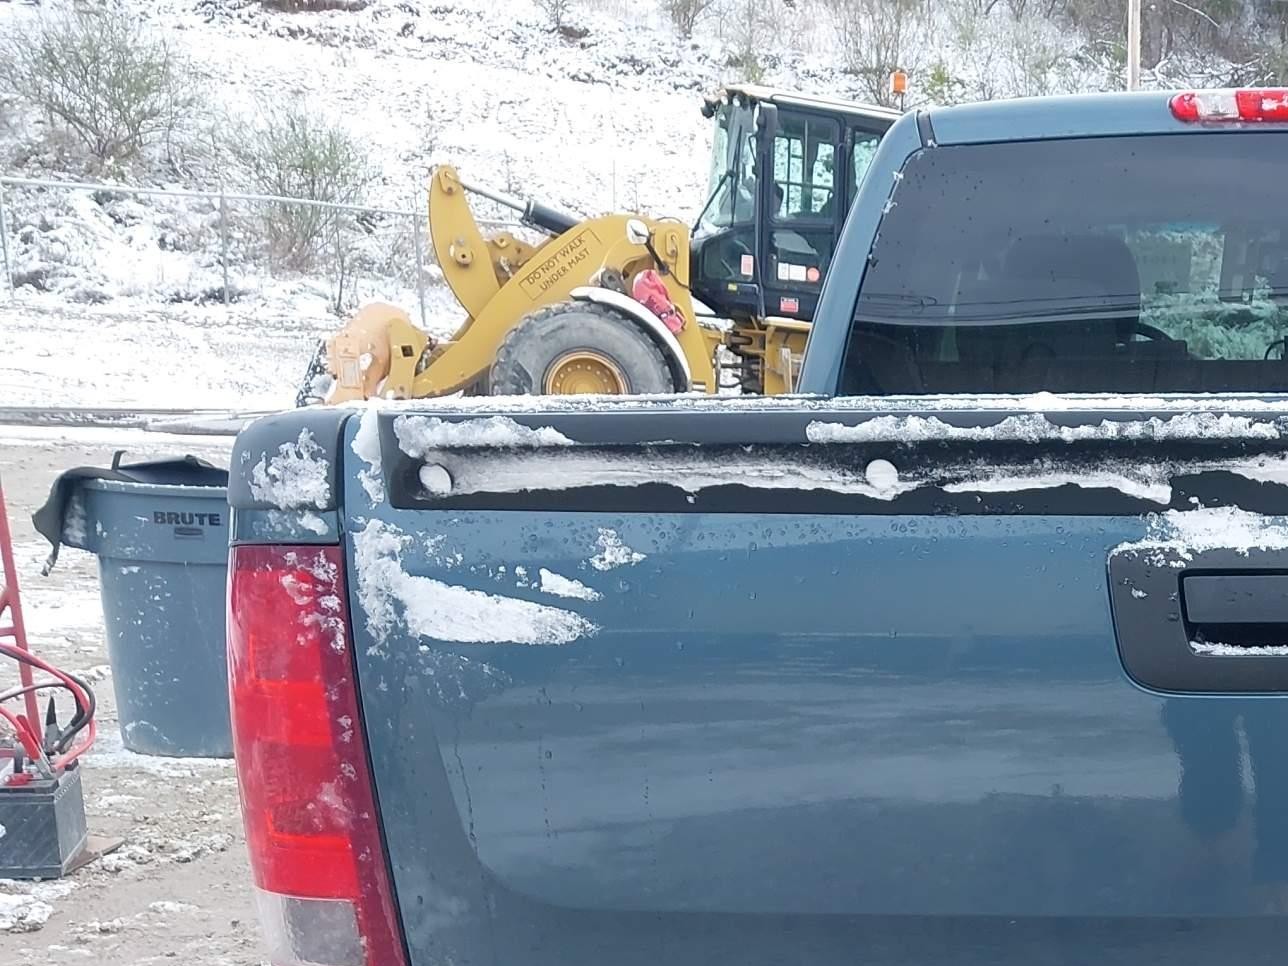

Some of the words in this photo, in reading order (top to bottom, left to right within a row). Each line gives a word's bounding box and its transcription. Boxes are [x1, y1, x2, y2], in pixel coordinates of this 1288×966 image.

[526, 270, 542, 285] DO
[541, 253, 561, 273] NOT
[560, 234, 586, 258] WALK
[539, 266, 569, 291] UNDER
[567, 246, 591, 270] MAST
[153, 511, 221, 526] BRUTE
